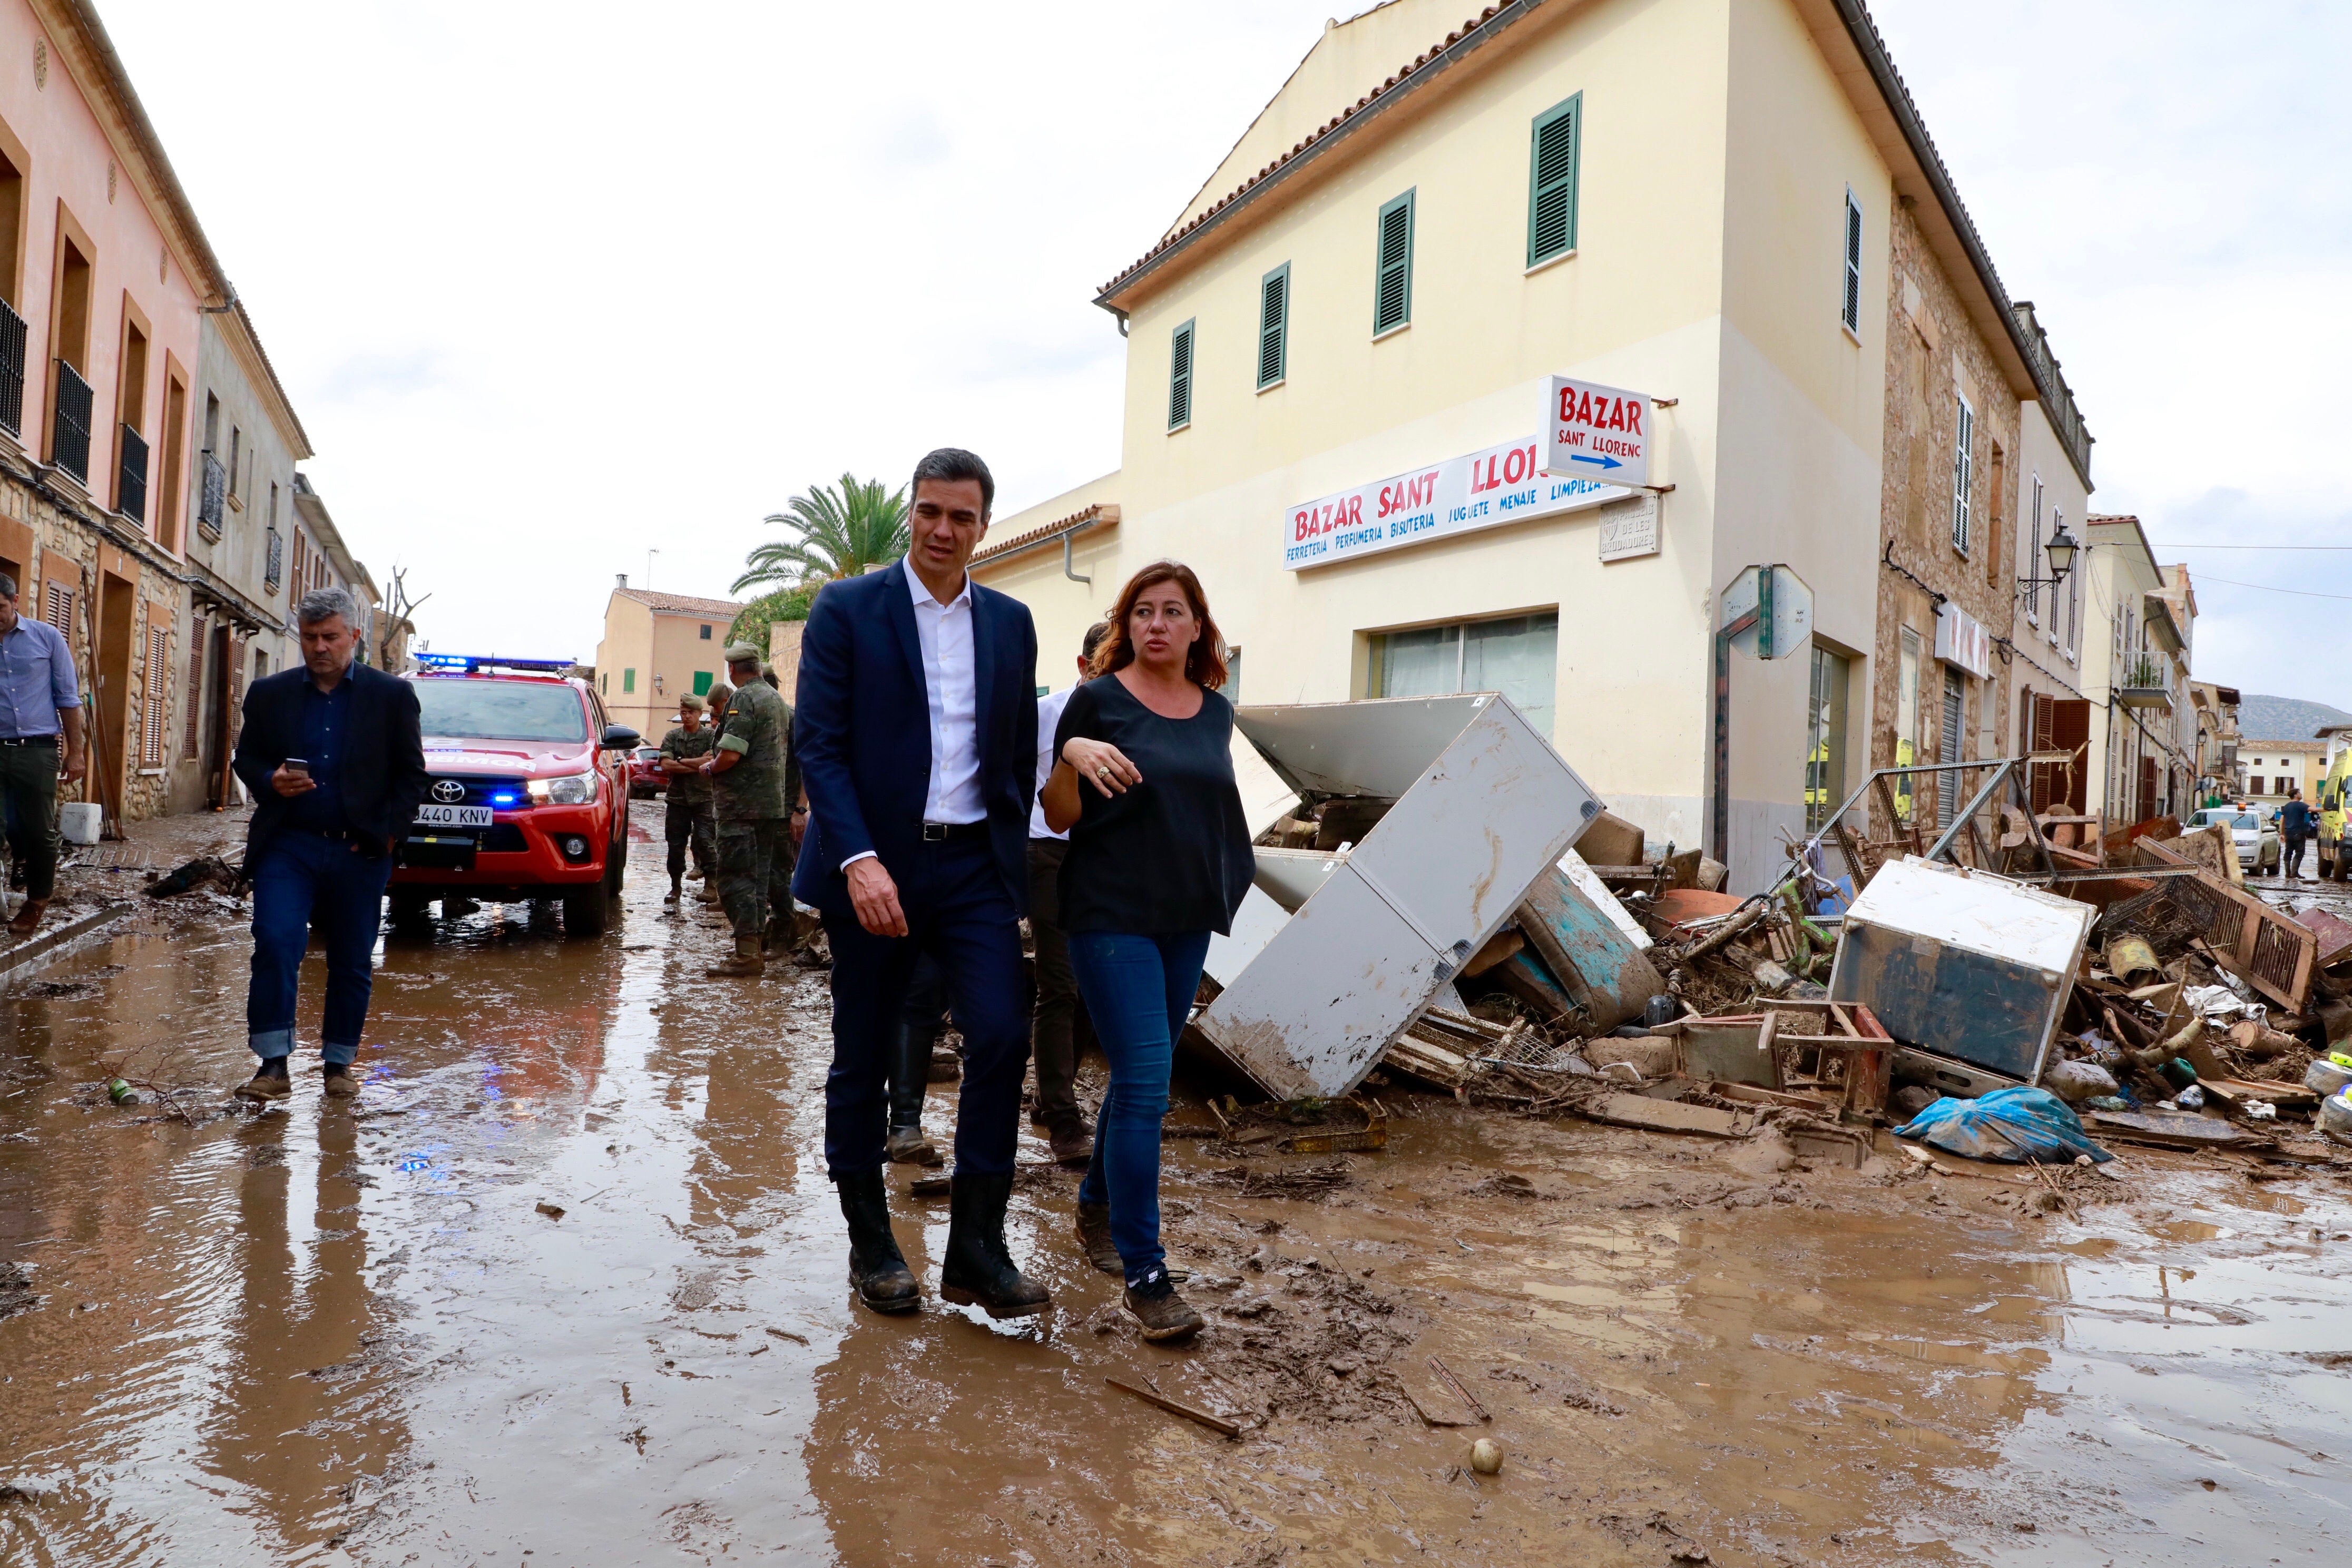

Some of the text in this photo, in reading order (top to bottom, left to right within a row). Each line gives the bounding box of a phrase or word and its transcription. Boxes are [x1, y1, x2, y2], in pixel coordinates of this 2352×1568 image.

[1559, 387, 1642, 436] BAZAR
[1558, 429, 1585, 447] SANT
[1295, 495, 1363, 541] BAZAR
[1378, 471, 1439, 518] SANT
[1619, 504, 1653, 521] PASSEIG
[1287, 539, 1327, 561] FERRETERIA
[1336, 526, 1382, 549] PERFUMERIA
[1390, 512, 1434, 537] BISUTERIA
[1448, 501, 1489, 523] JUGUETE
[1499, 489, 1536, 512] MENAJE
[1622, 520, 1650, 535] DE LES
[415, 808, 488, 823] 440 KNV
[1148, 1270, 1158, 1280] NIKE
